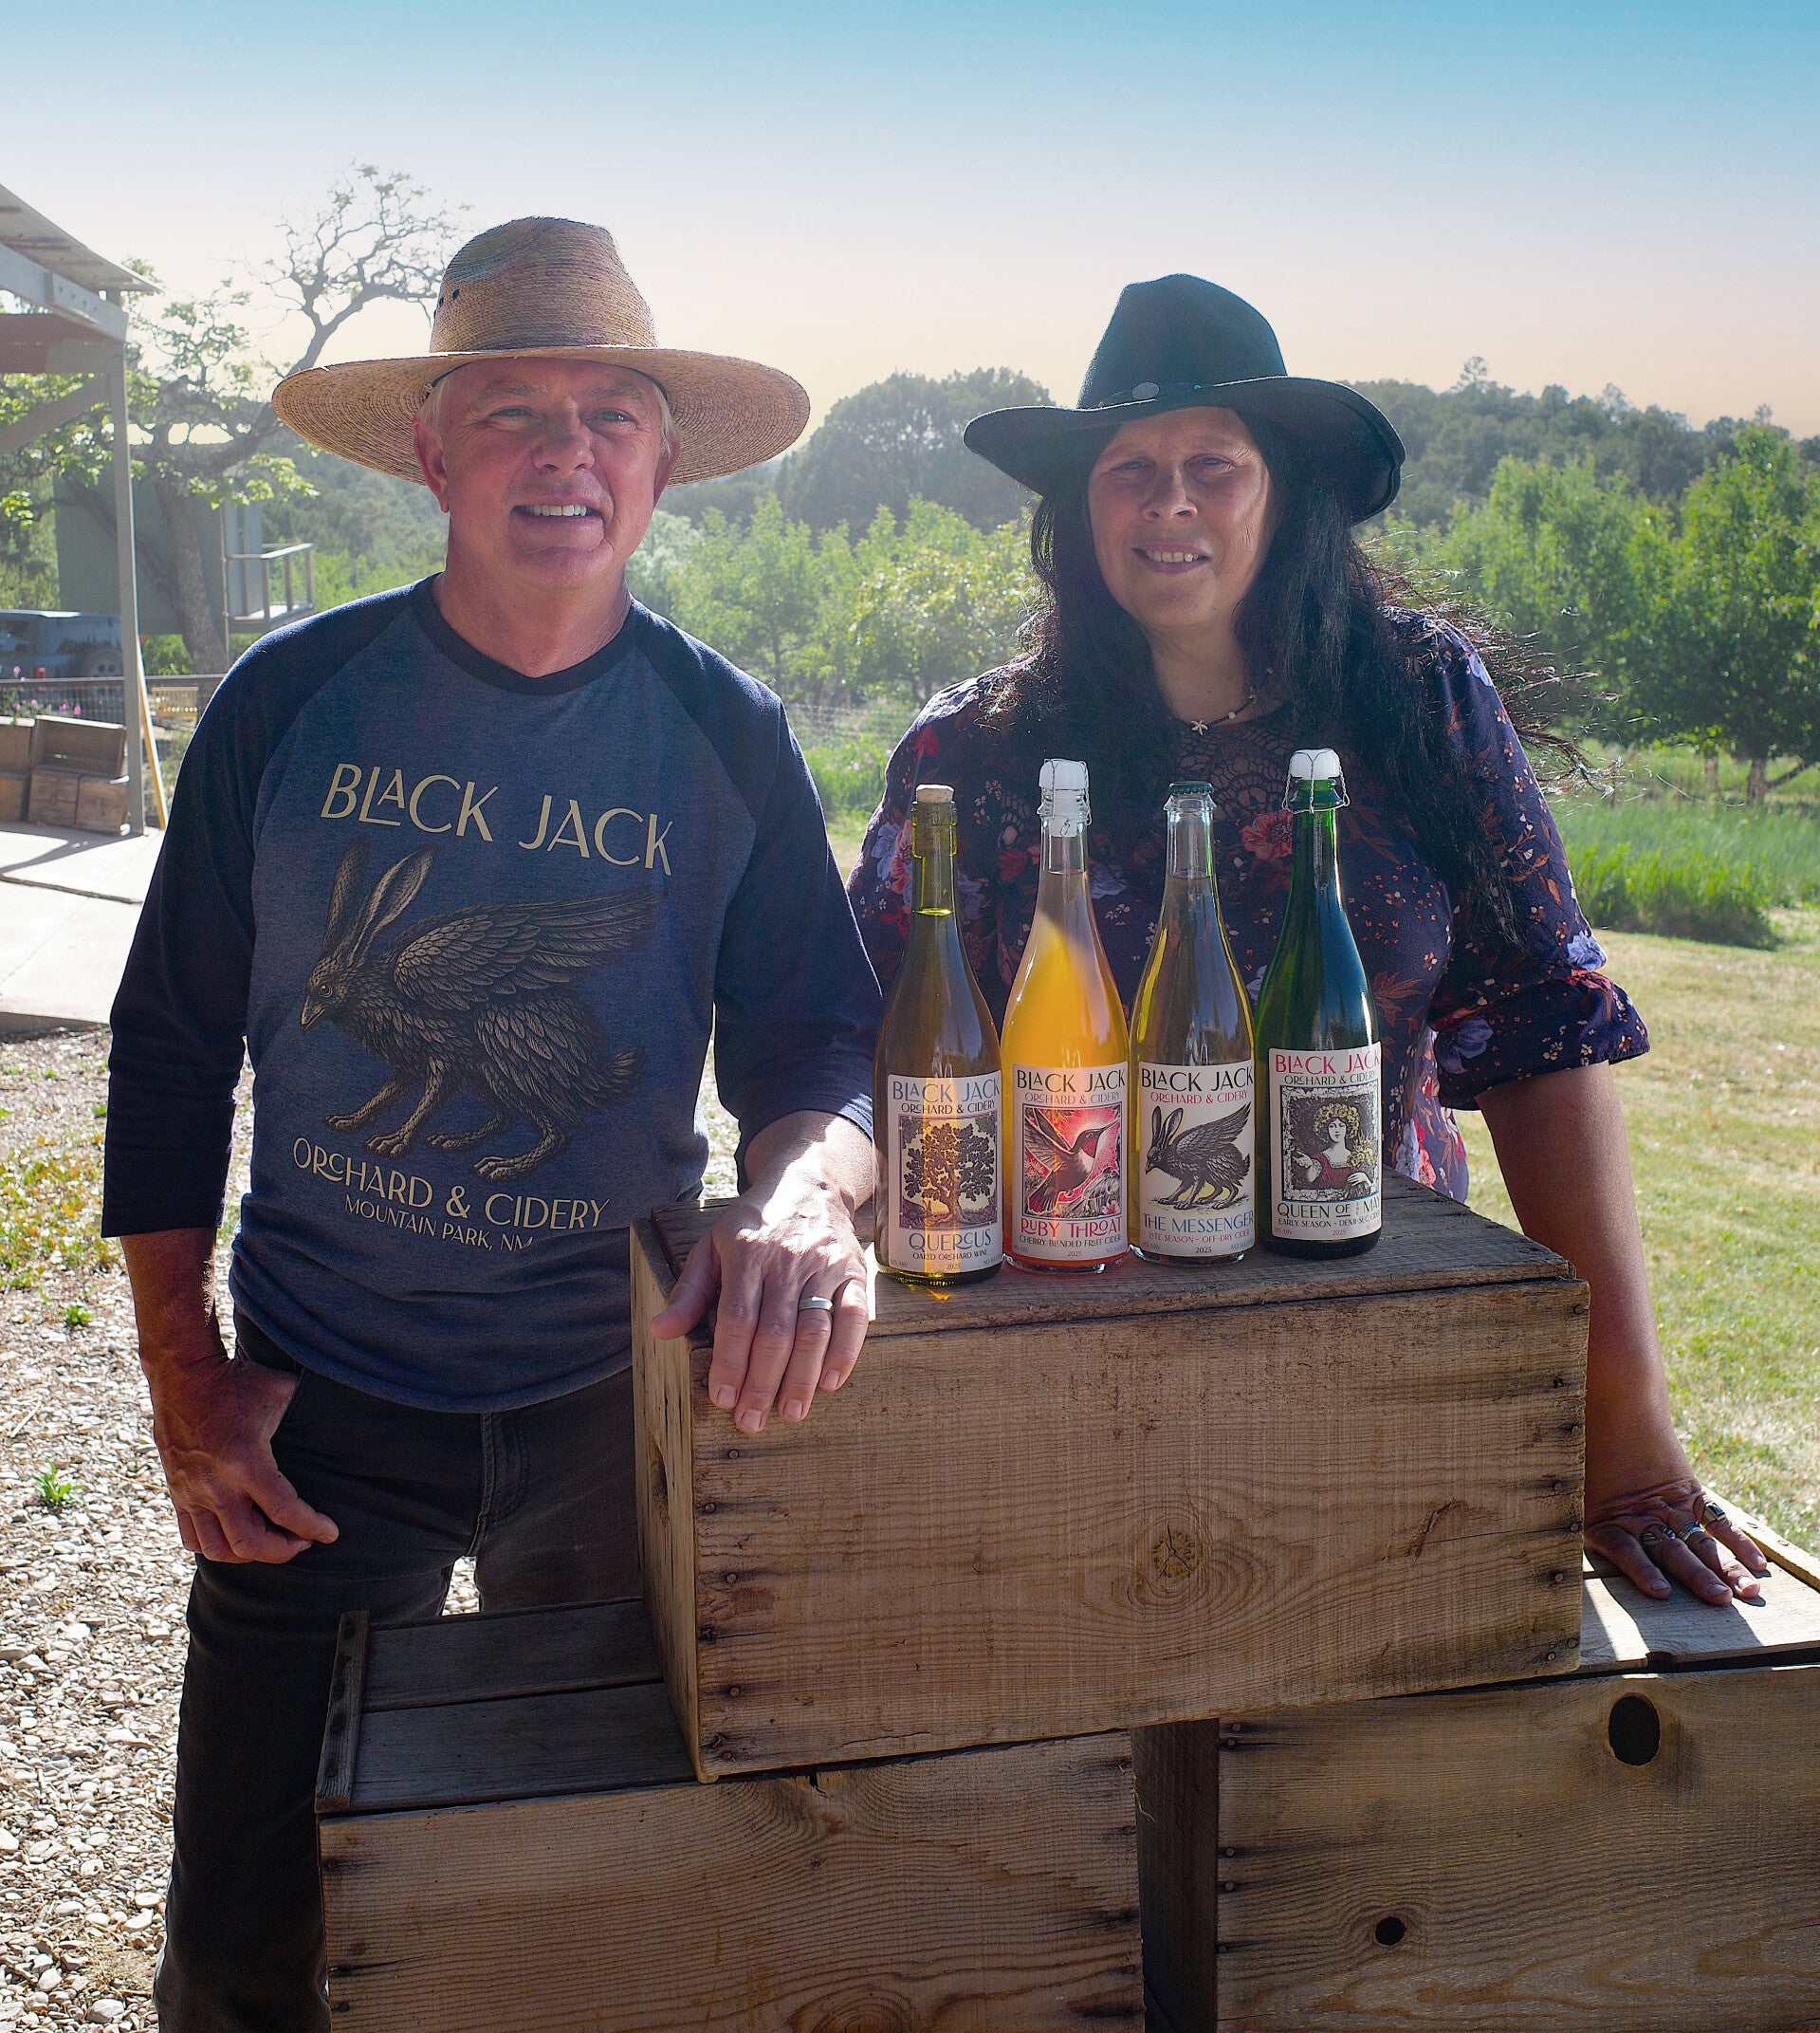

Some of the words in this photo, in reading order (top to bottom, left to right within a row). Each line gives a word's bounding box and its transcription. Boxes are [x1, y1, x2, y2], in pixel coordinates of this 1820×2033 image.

[321, 763, 498, 841] BLACK
[519, 794, 674, 877] JACK
[1275, 1054, 1336, 1075] BLACK
[1344, 1048, 1380, 1074] JACK
[1017, 1069, 1076, 1093] BLACK
[1084, 1068, 1126, 1093] JACK
[1141, 1068, 1203, 1092] BLACK
[1211, 1066, 1253, 1091] JACK
[1284, 1075, 1336, 1085] ORCHARD
[1339, 1076, 1347, 1085] &
[1350, 1070, 1375, 1082] CIDERY
[892, 1081, 953, 1102] BLACK
[962, 1078, 1000, 1102] JACK
[1024, 1092, 1075, 1104] ORCHARD
[1080, 1095, 1087, 1104] &
[1091, 1091, 1121, 1103] CIDERY
[1150, 1091, 1203, 1104] ORCHARD
[1205, 1094, 1214, 1104] &
[1217, 1090, 1248, 1103] CIDERY
[901, 1102, 953, 1115] ORCHARD
[957, 1103, 965, 1114] &
[967, 1100, 995, 1113] CIDERY
[293, 1137, 432, 1208] ORCHARD
[446, 1186, 471, 1218] &
[485, 1193, 610, 1229] CIDERY
[1277, 1202, 1330, 1219] QUEEN
[1335, 1203, 1351, 1215] OF
[1363, 1195, 1381, 1212] MAY
[345, 1194, 436, 1237] MOUNTAIN
[442, 1223, 493, 1251] PARK,
[1020, 1217, 1060, 1237] RUBY
[1067, 1215, 1123, 1238] THROAT
[1143, 1212, 1167, 1231] THE
[1171, 1211, 1254, 1233] MESSENGER
[1278, 1218, 1298, 1227] EARLY
[1301, 1220, 1333, 1229] SEASON
[909, 1228, 991, 1252] QUERCUS
[1019, 1234, 1047, 1246] CHERRY
[1049, 1239, 1082, 1248] BLENDED
[1084, 1238, 1102, 1247] FRUIT
[1104, 1234, 1121, 1244] CIDER
[1164, 1235, 1194, 1244] SEASON
[1202, 1234, 1233, 1244] OFF-DRY
[1234, 1229, 1251, 1238] CIDER
[938, 1252, 972, 1261] ORCHARD
